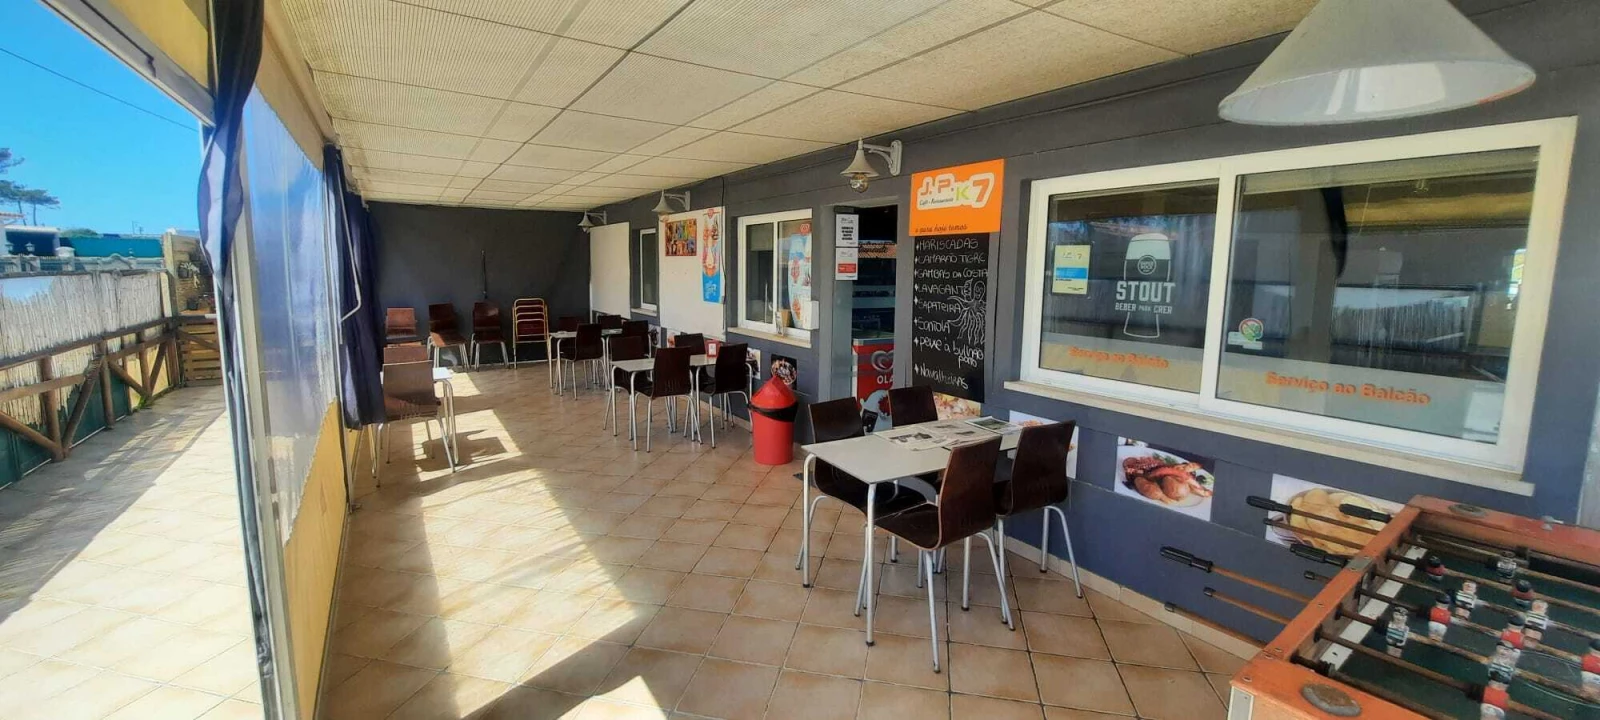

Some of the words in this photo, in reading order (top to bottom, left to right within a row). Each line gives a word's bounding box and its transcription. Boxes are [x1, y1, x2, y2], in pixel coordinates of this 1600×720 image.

[1115, 280, 1176, 303] STOUT
[1115, 302, 1137, 312] BEBER
[1153, 305, 1173, 315] CRER
[1265, 371, 1329, 393] Serviço
[1333, 382, 1356, 396] ao
[1361, 383, 1431, 405] Balcão
